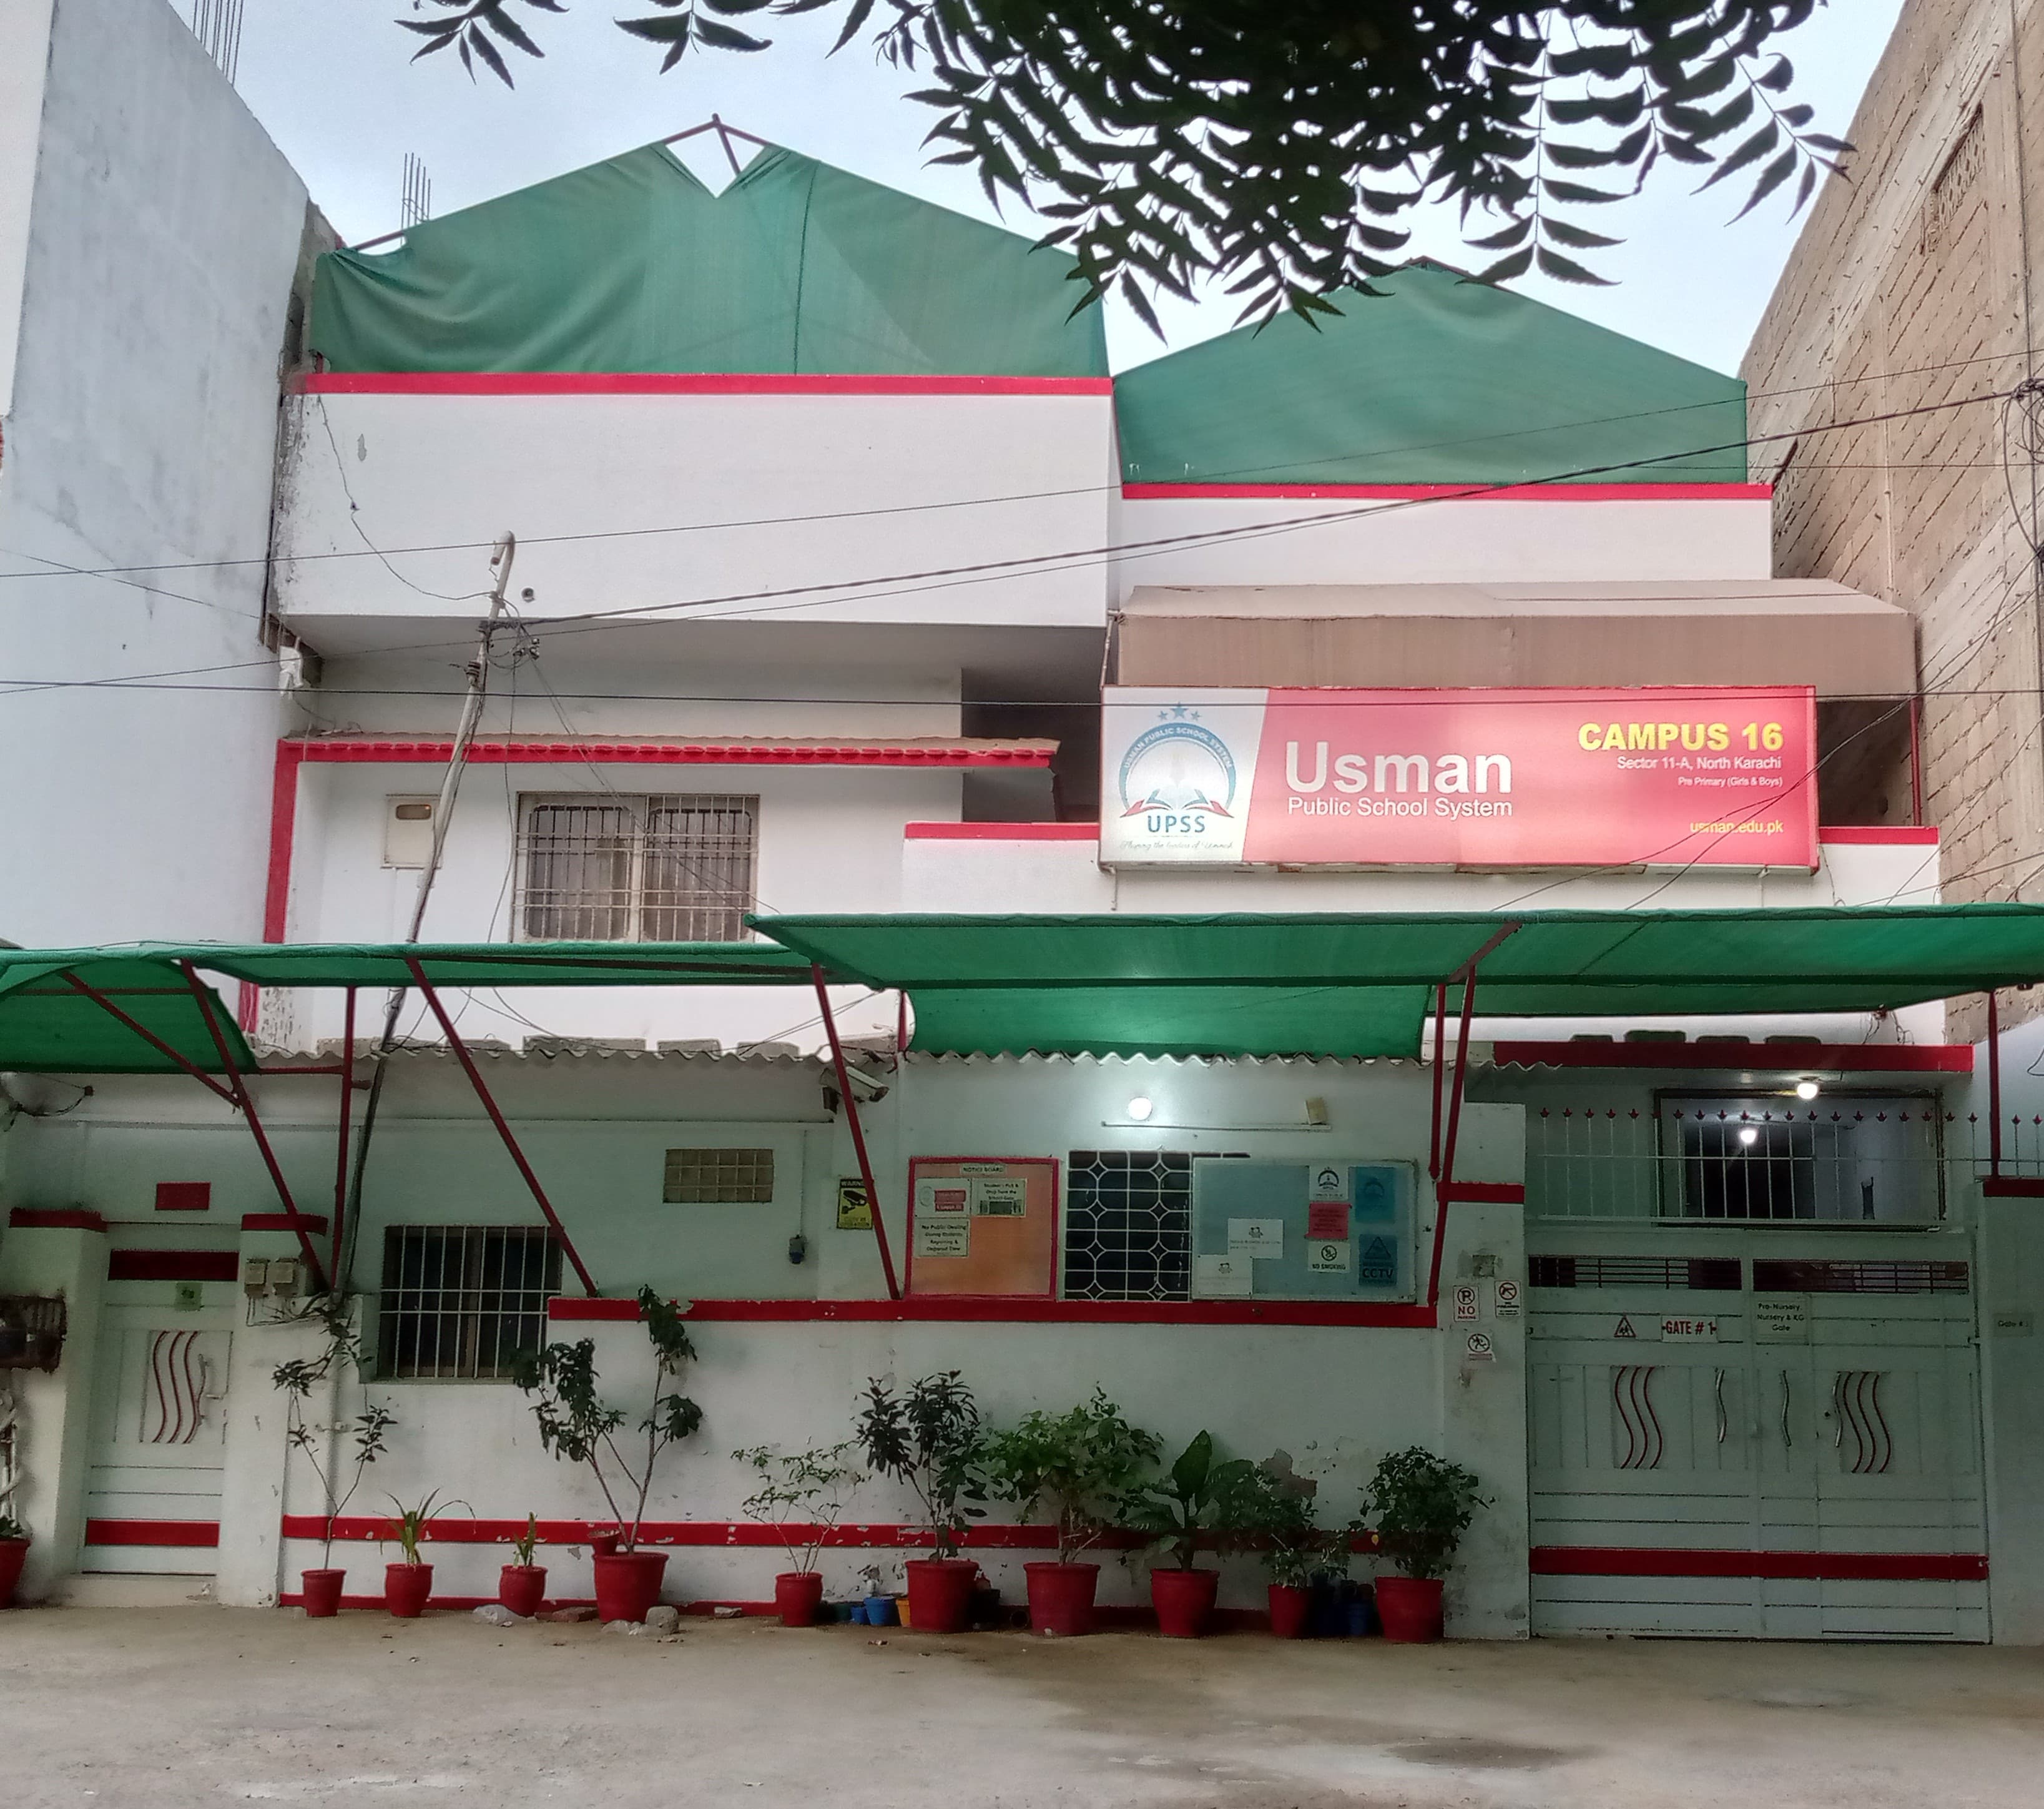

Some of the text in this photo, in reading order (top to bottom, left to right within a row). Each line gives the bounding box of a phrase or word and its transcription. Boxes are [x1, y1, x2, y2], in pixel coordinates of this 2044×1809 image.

[1145, 727, 1174, 746] PUBLIC
[1176, 727, 1209, 742] SCHOOL
[1578, 722, 1784, 751] CAMPUS 16
[1285, 741, 1512, 794] Usman
[1617, 756, 1782, 771] Sector 11-A, North Karachi
[1678, 776, 1783, 787] Pre Primary (Girls & Boys)
[1288, 797, 1512, 821] Public School System
[1147, 815, 1206, 833] UPSS
[1689, 821, 1784, 835] usman.edu.pk
[1362, 1268, 1393, 1279] CCTV
[1458, 1306, 1475, 1314] NO
[1757, 1314, 1784, 1322] Nursery
[1665, 1321, 1714, 1334] GATE # 1
